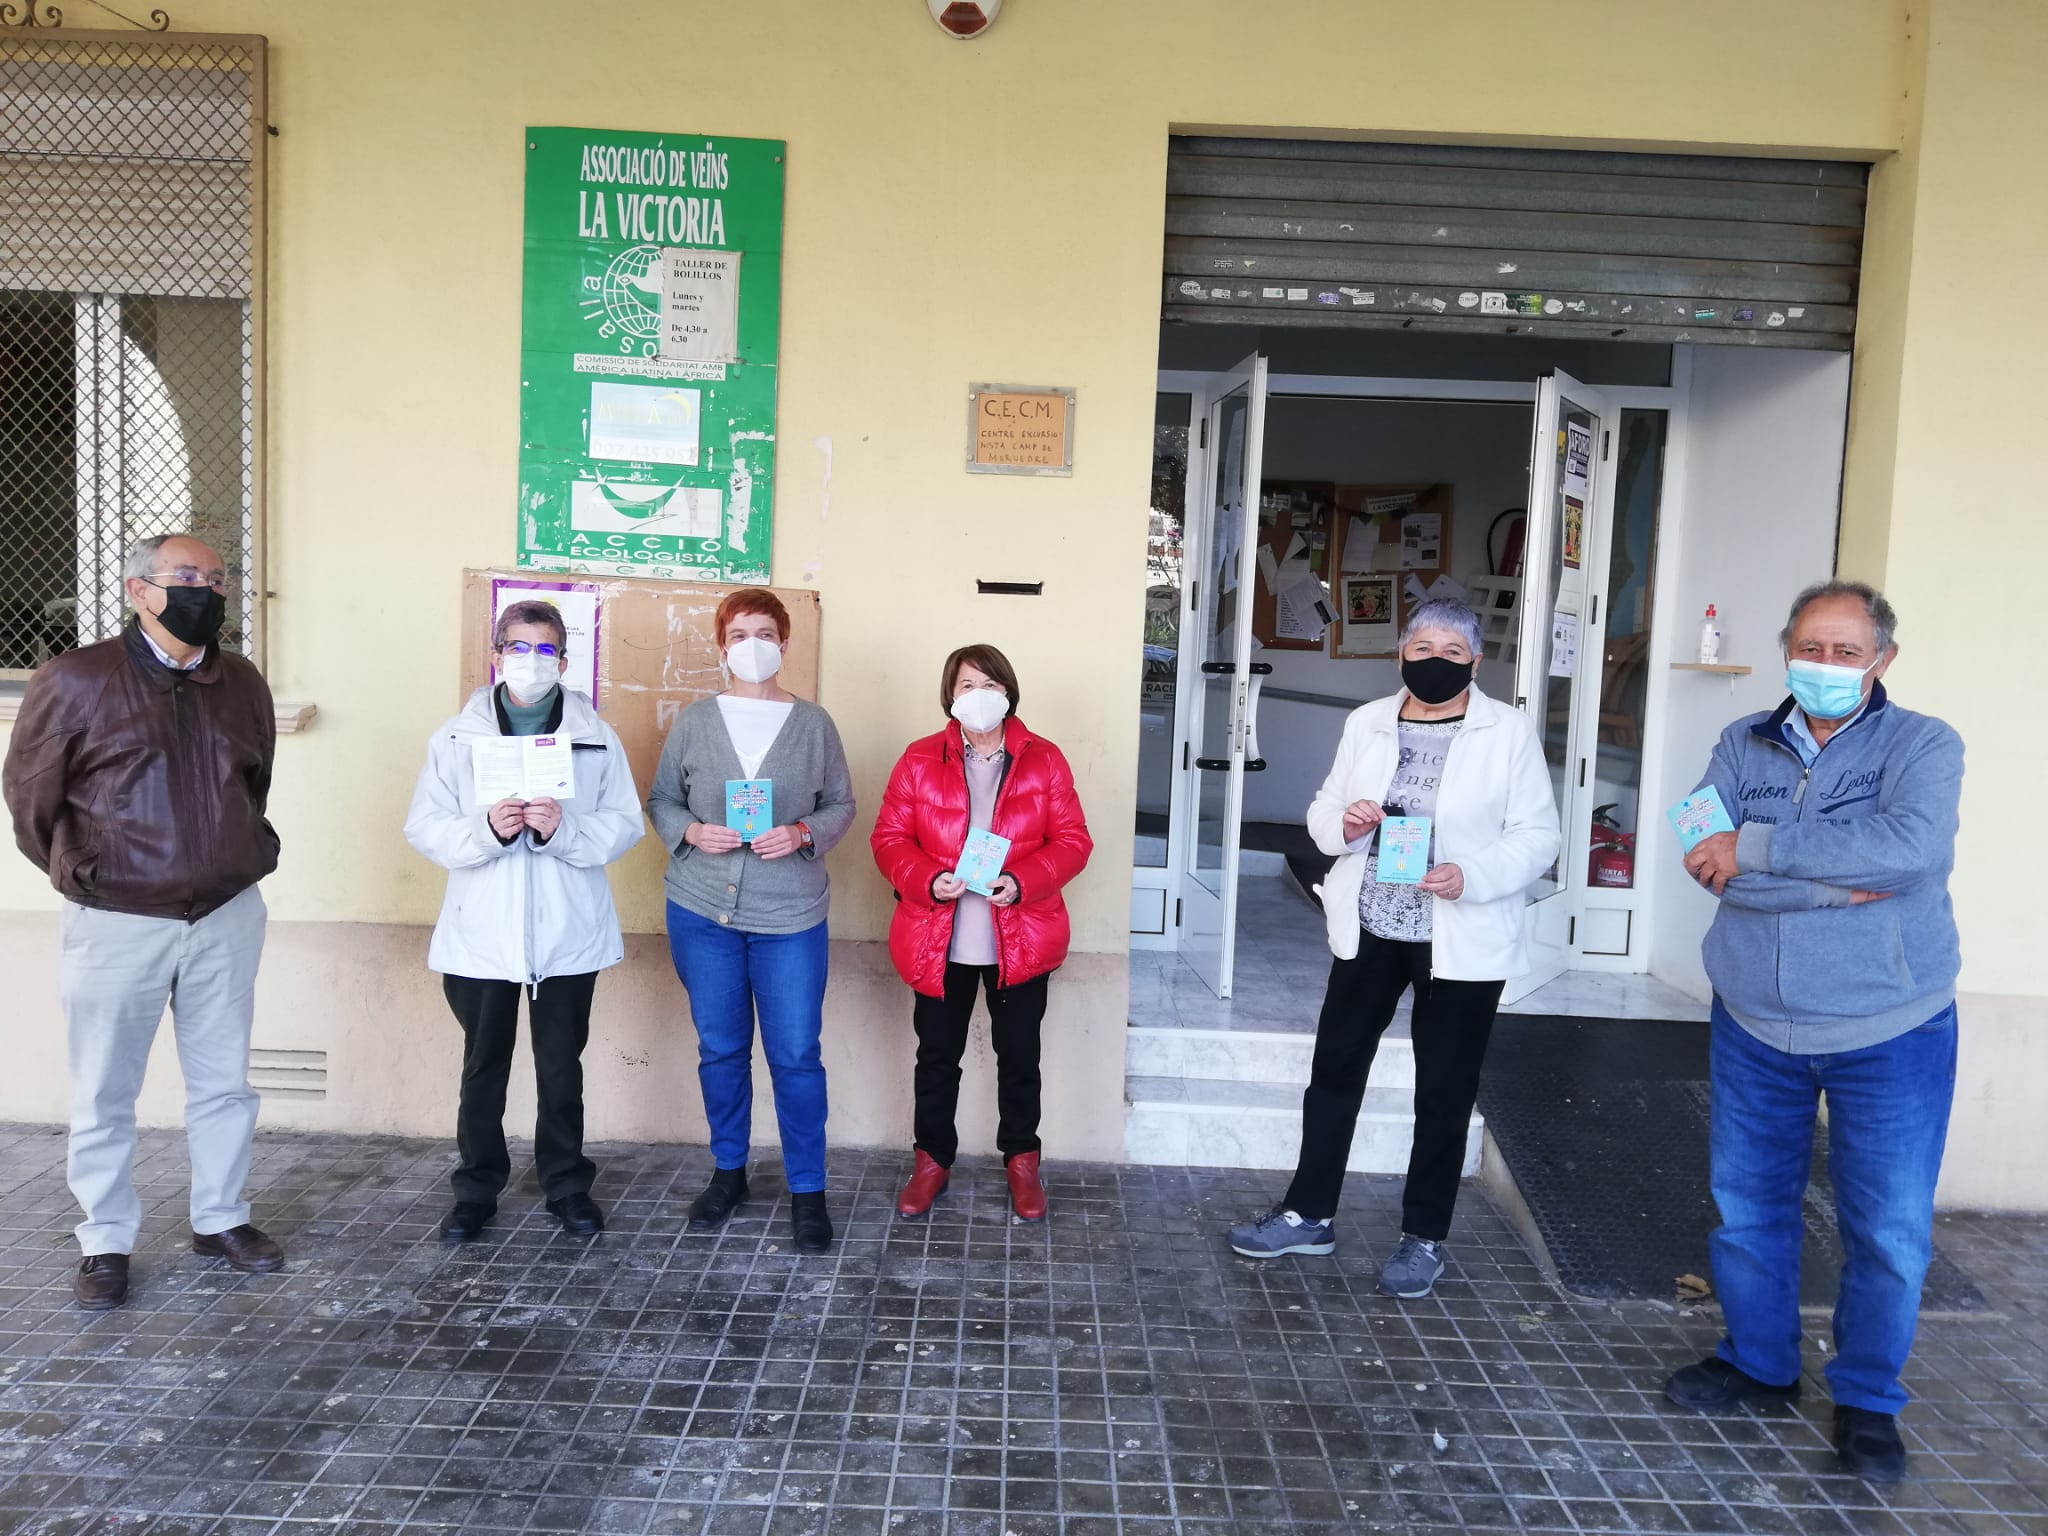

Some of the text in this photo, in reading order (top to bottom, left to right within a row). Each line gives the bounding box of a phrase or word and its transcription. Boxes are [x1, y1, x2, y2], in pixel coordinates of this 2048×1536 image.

[580, 138, 729, 191] ASSOCIACIÓ DE VEÏNS
[578, 190, 726, 246] LA VICTORIA
[673, 259, 728, 270] TALLER DE
[673, 270, 722, 280] BOLILLOS
[672, 291, 704, 303] Lunes y
[672, 303, 700, 312] martes
[671, 324, 683, 333] De
[628, 358, 640, 366] DE
[642, 359, 699, 370] SOLIDARITAT
[631, 367, 673, 377] LLATINA
[981, 430, 1015, 438] CENTRE
[980, 442, 1006, 450] NISTA
[1012, 443, 1037, 451] CAMP
[571, 533, 722, 552] ACCIÓ
[570, 546, 720, 564] ECOLOGISTA
[1146, 683, 1174, 693] RACI
